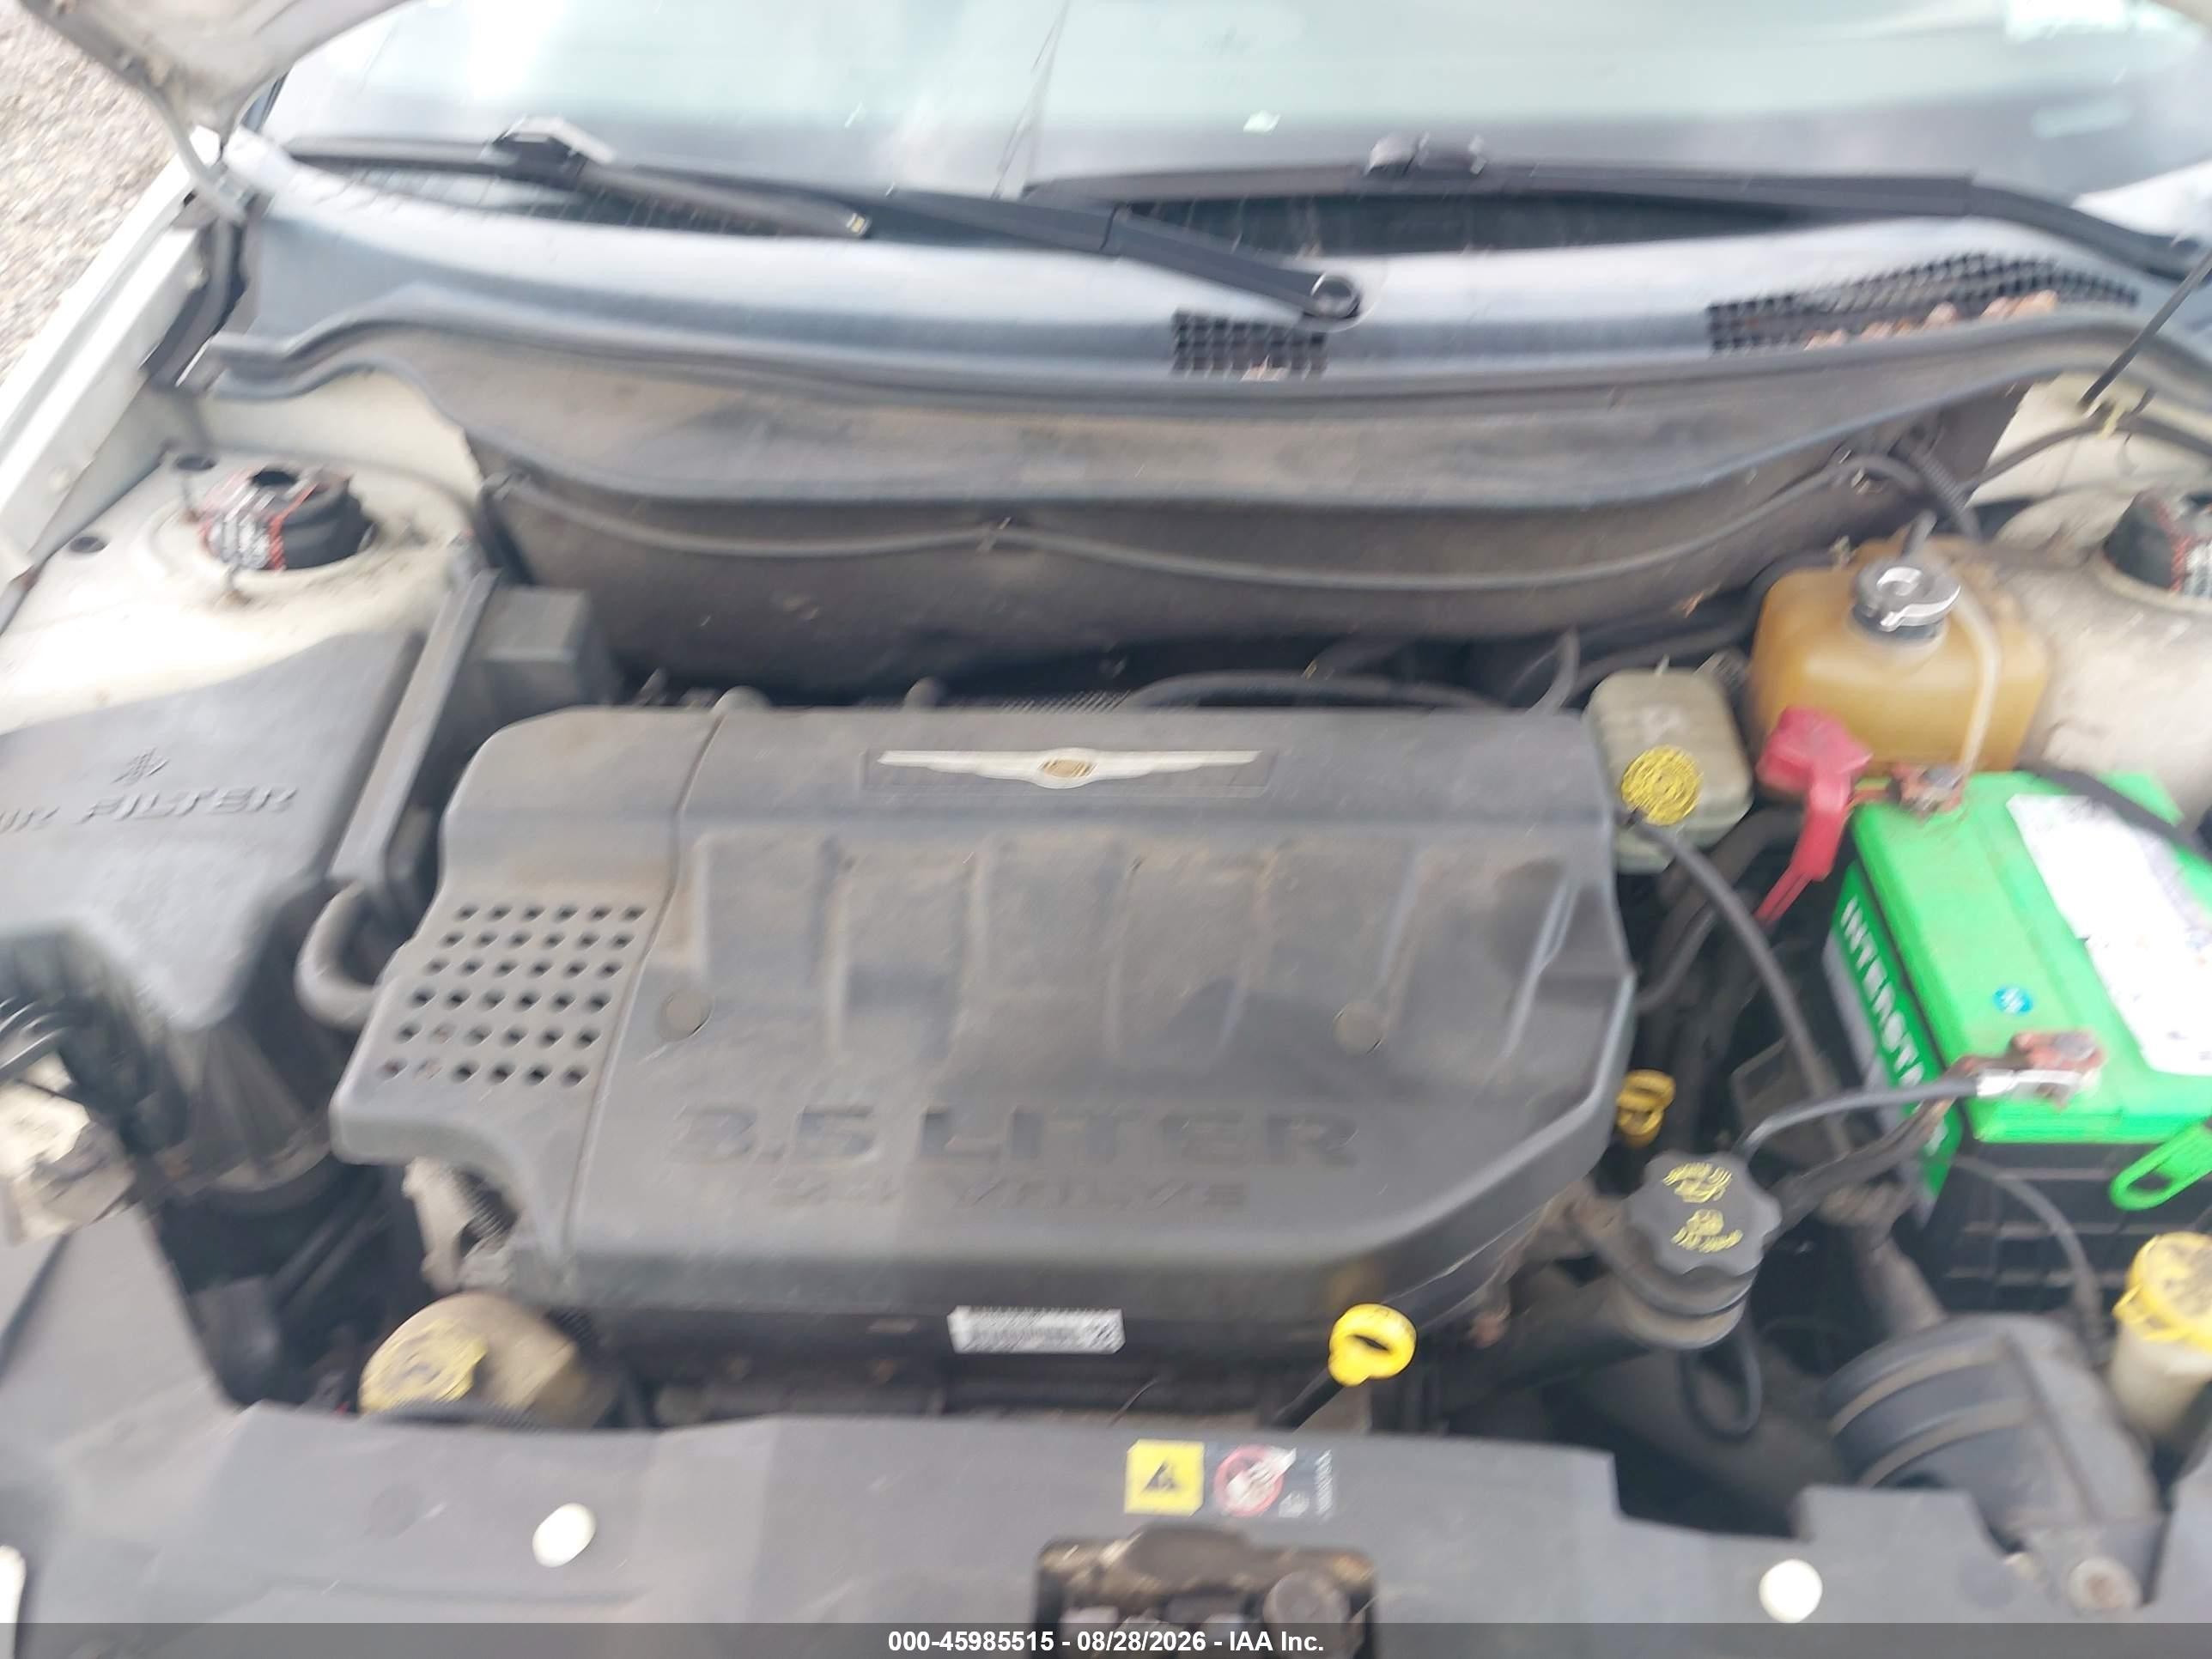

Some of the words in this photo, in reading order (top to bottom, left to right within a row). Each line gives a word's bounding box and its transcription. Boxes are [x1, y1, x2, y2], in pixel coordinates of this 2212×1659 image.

[0, 806, 60, 834] IR
[76, 786, 298, 825] FILTER
[672, 1103, 879, 1164] 3.5
[915, 1103, 1361, 1166] LITER
